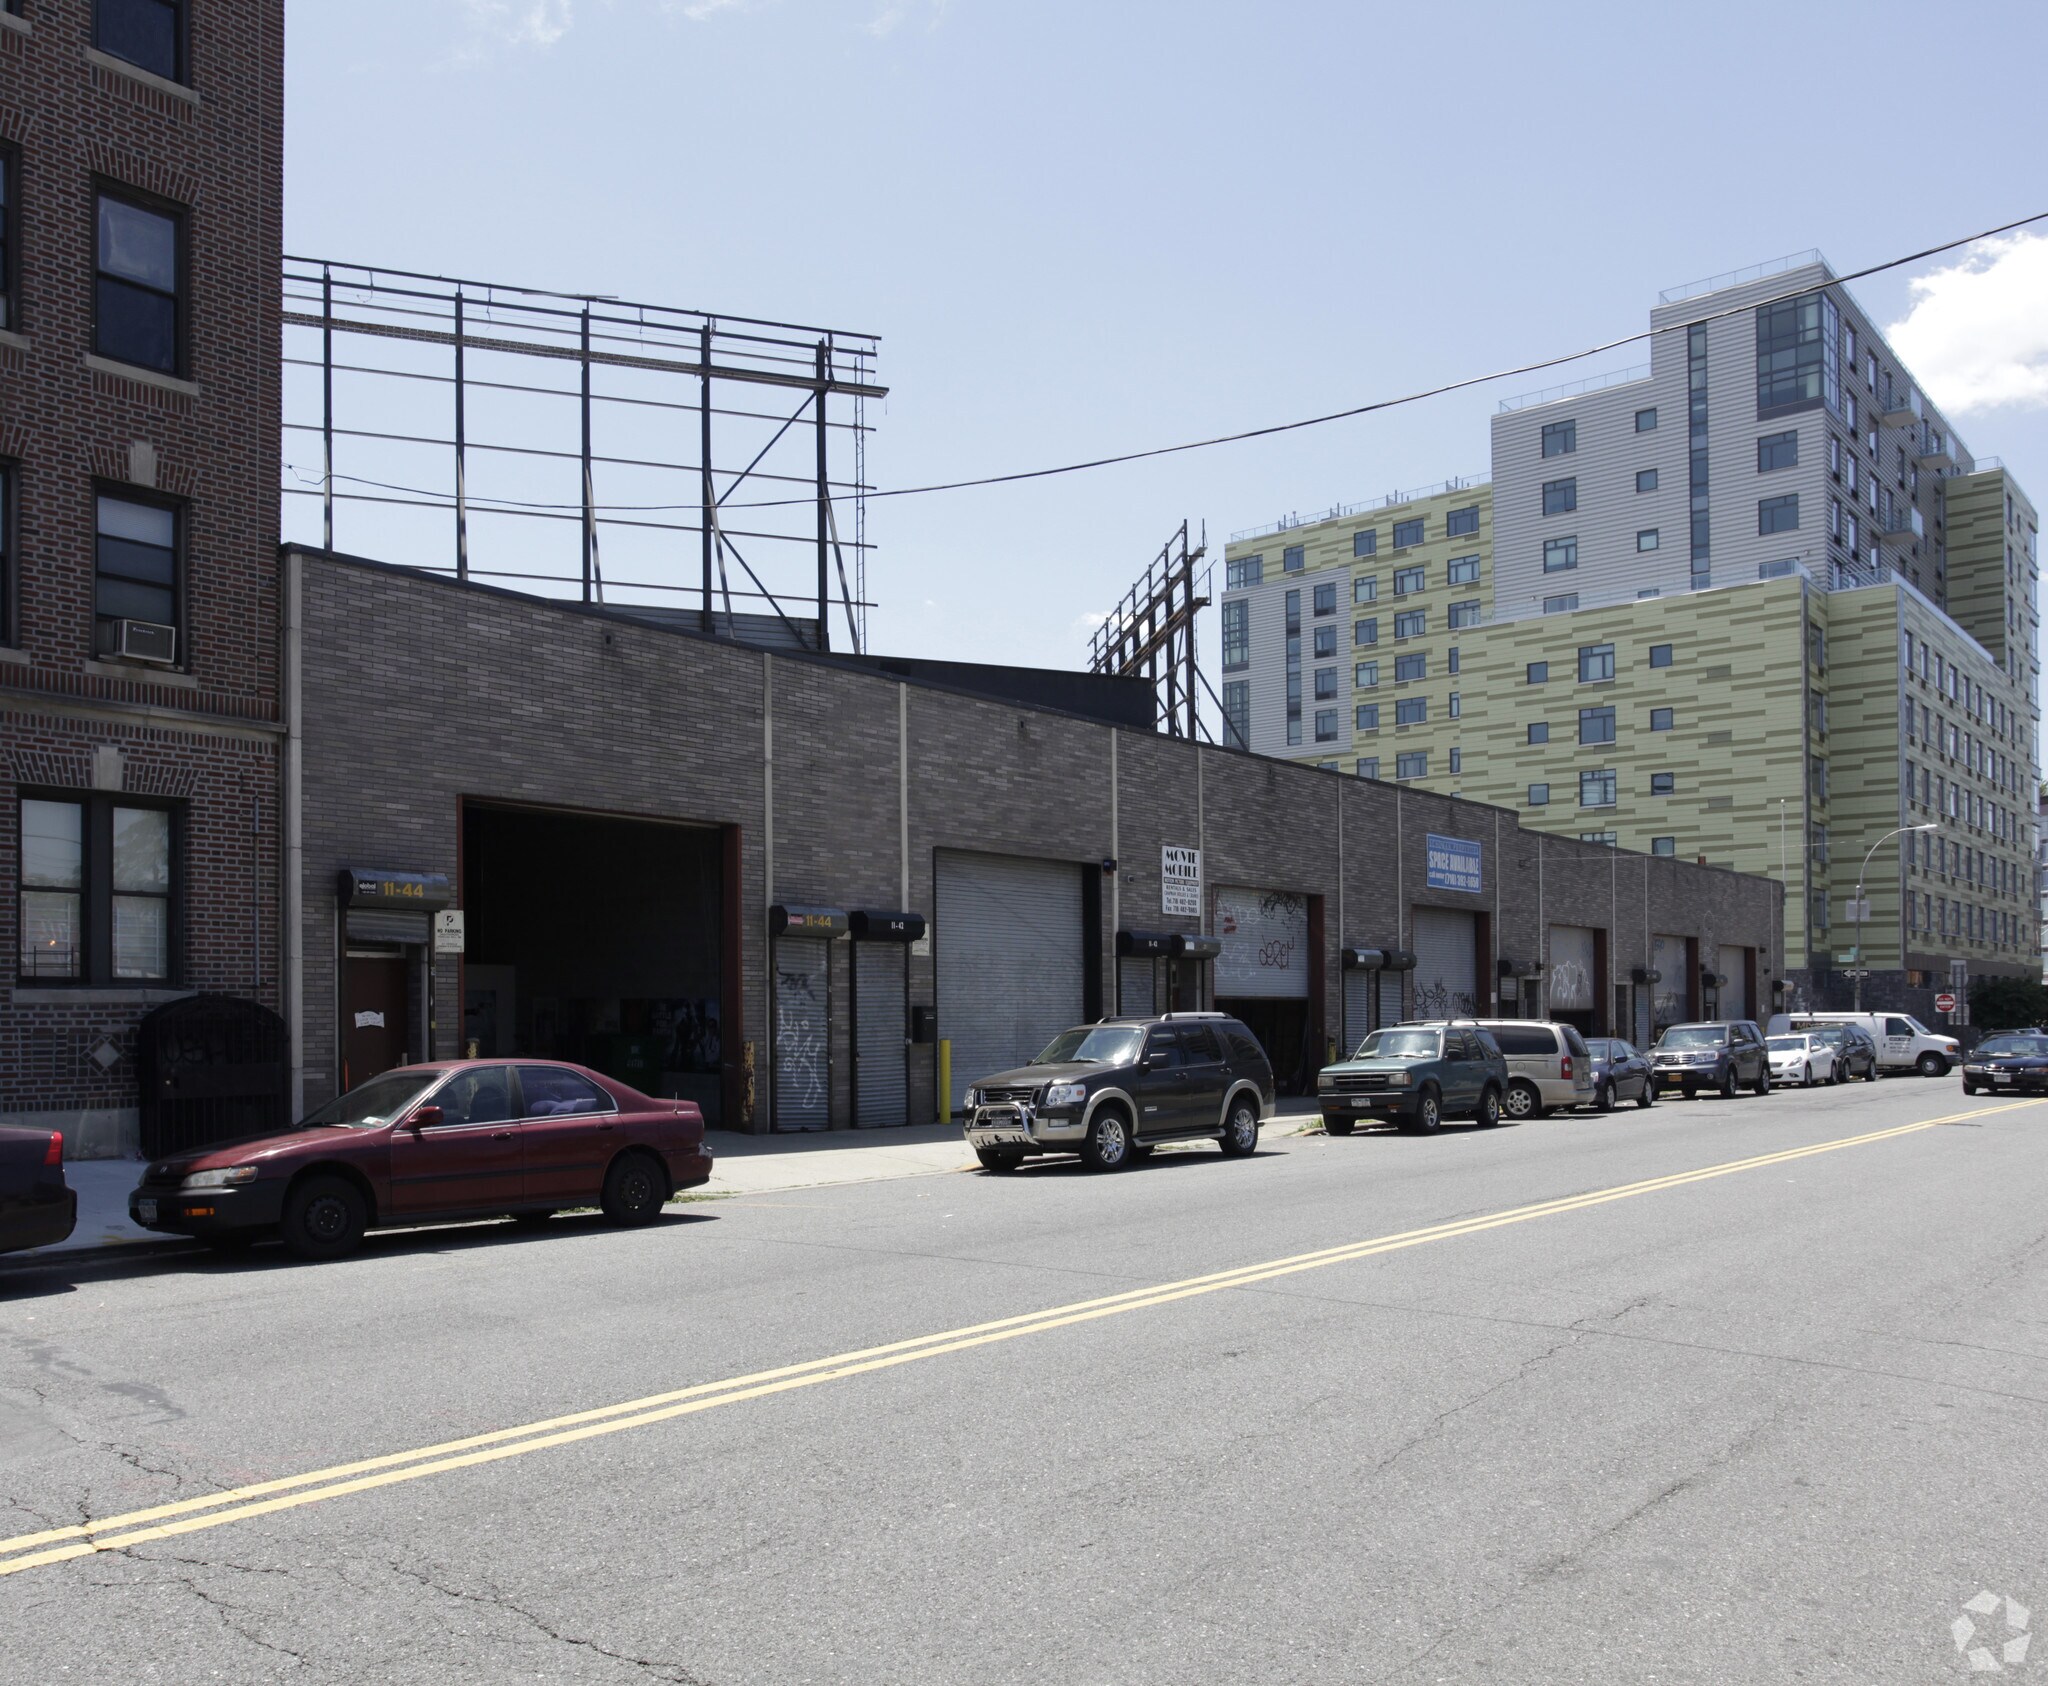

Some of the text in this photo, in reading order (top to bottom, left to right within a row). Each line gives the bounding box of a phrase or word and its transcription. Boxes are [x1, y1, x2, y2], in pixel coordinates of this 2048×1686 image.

[1166, 849, 1197, 864] MOVIE
[1429, 851, 1478, 874] SPACE AVAILABLE
[1164, 863, 1198, 878] MOBILE
[384, 881, 423, 897] 11-44
[806, 915, 832, 928] 11-44
[891, 921, 904, 930] 11-42
